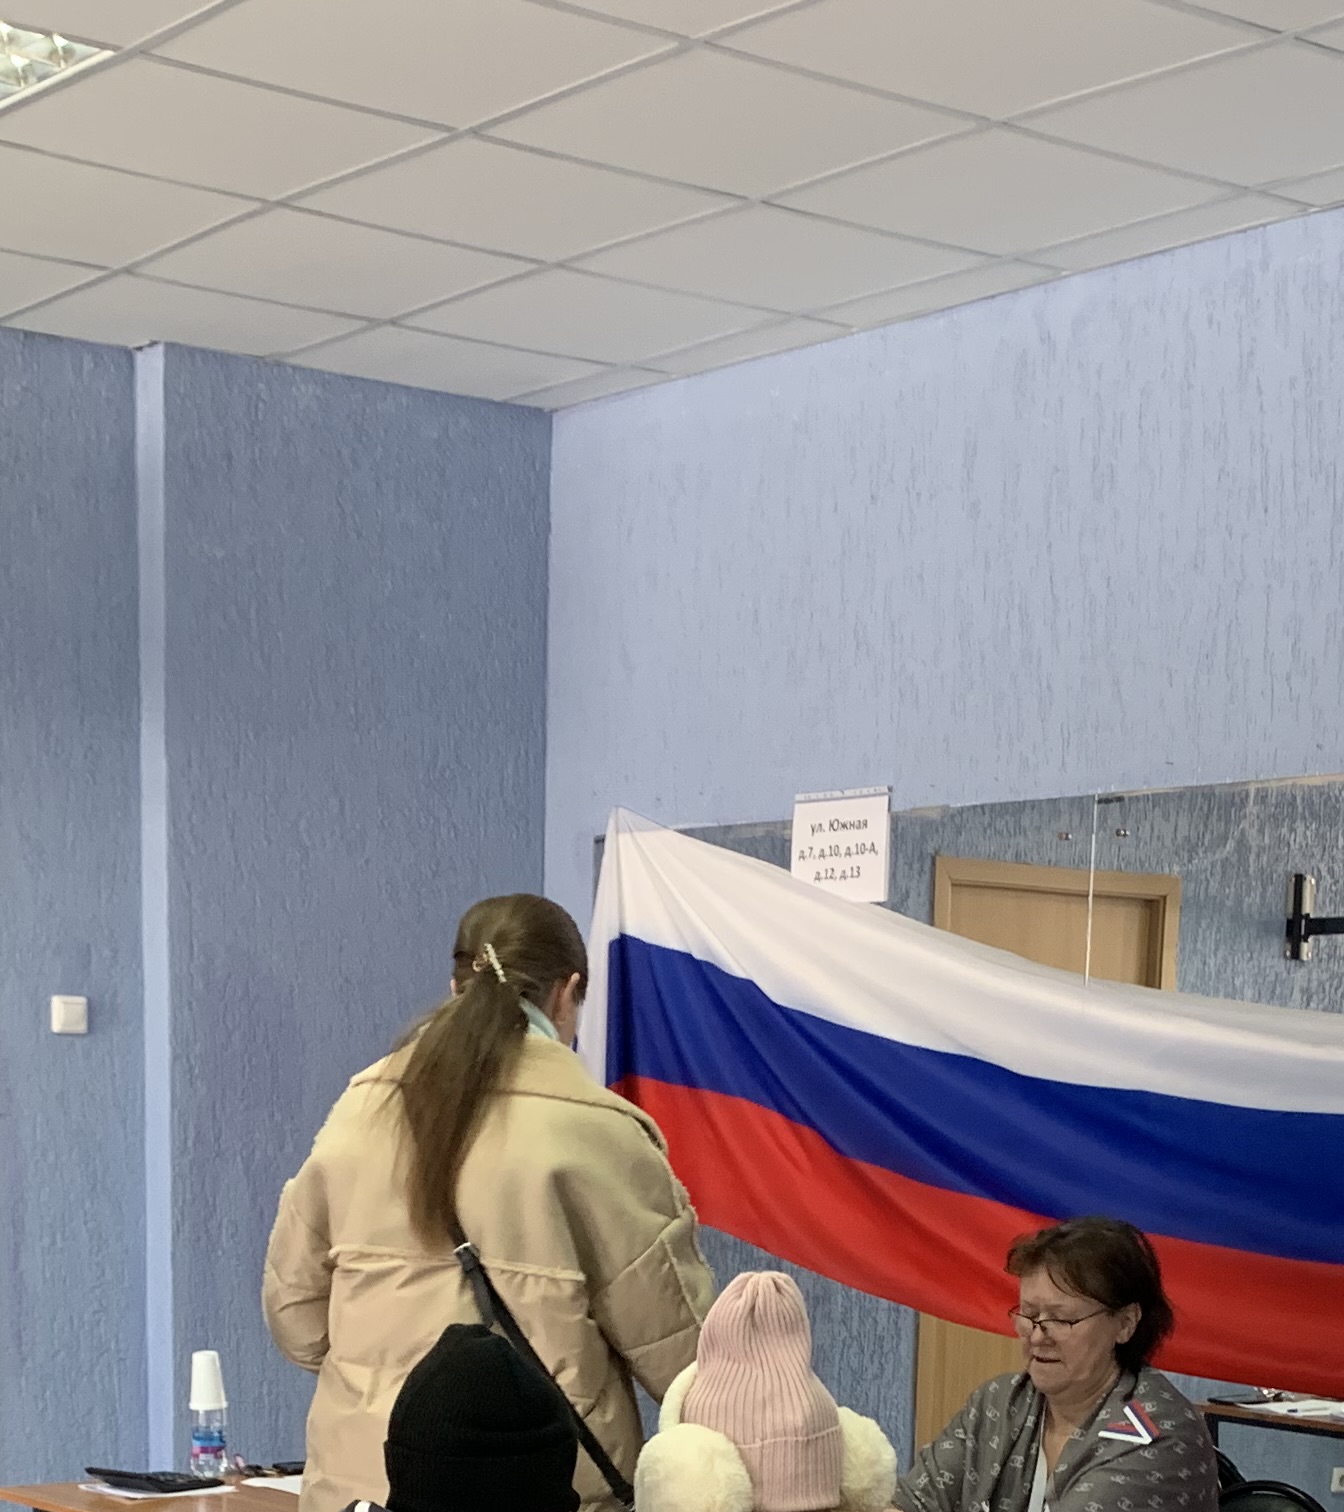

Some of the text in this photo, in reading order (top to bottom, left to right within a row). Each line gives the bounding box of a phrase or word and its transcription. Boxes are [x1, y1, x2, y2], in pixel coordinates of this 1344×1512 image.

[810, 818, 868, 837] ул. Южная
[818, 844, 842, 859] д.10,
[839, 865, 861, 880] д.13
